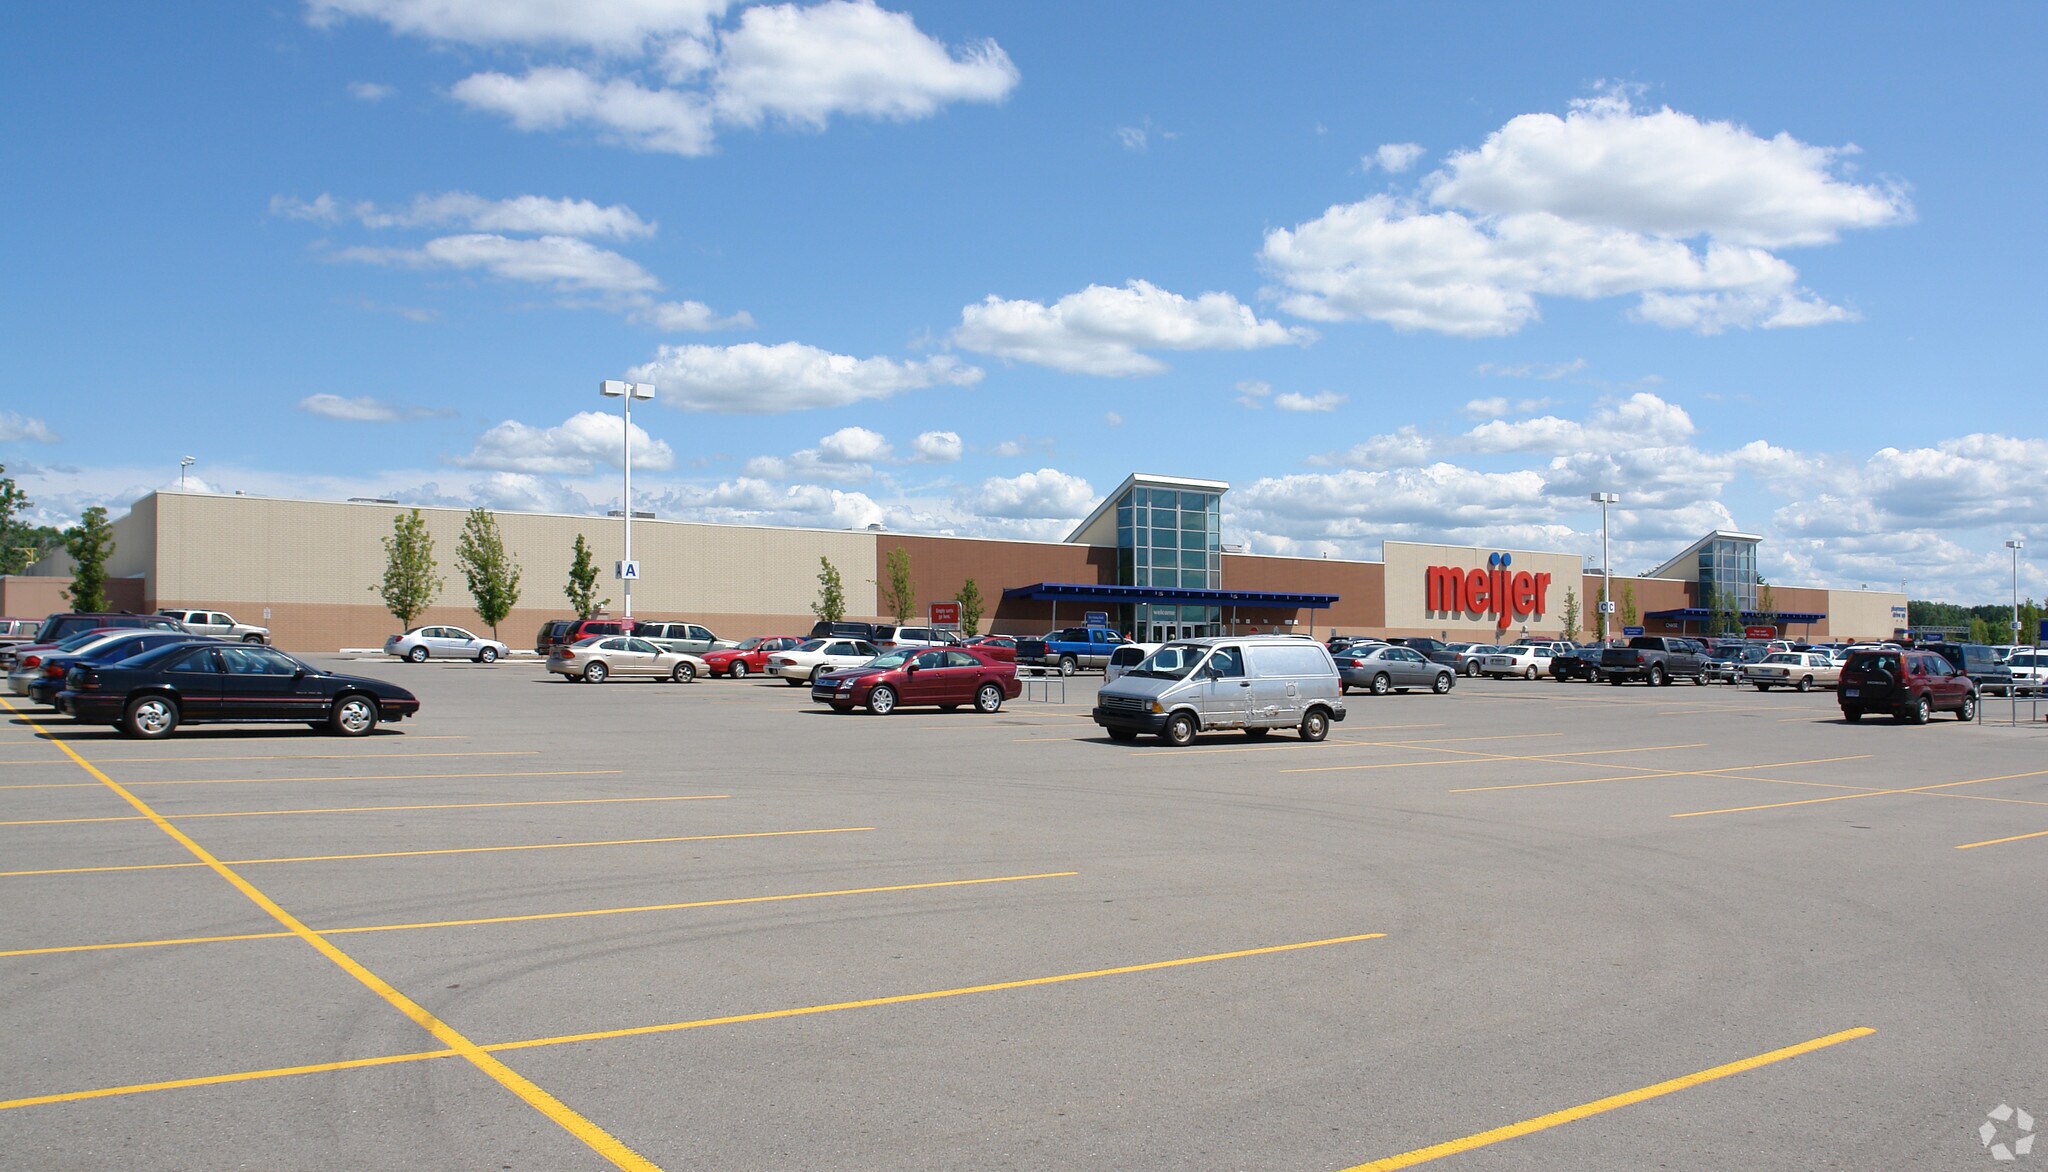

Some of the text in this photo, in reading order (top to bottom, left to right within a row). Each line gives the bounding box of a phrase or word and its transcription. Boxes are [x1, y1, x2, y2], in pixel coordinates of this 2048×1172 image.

[626, 564, 636, 576] A
[1425, 552, 1551, 628] meijer
[1600, 603, 1607, 611] C
[1610, 603, 1614, 611] C
